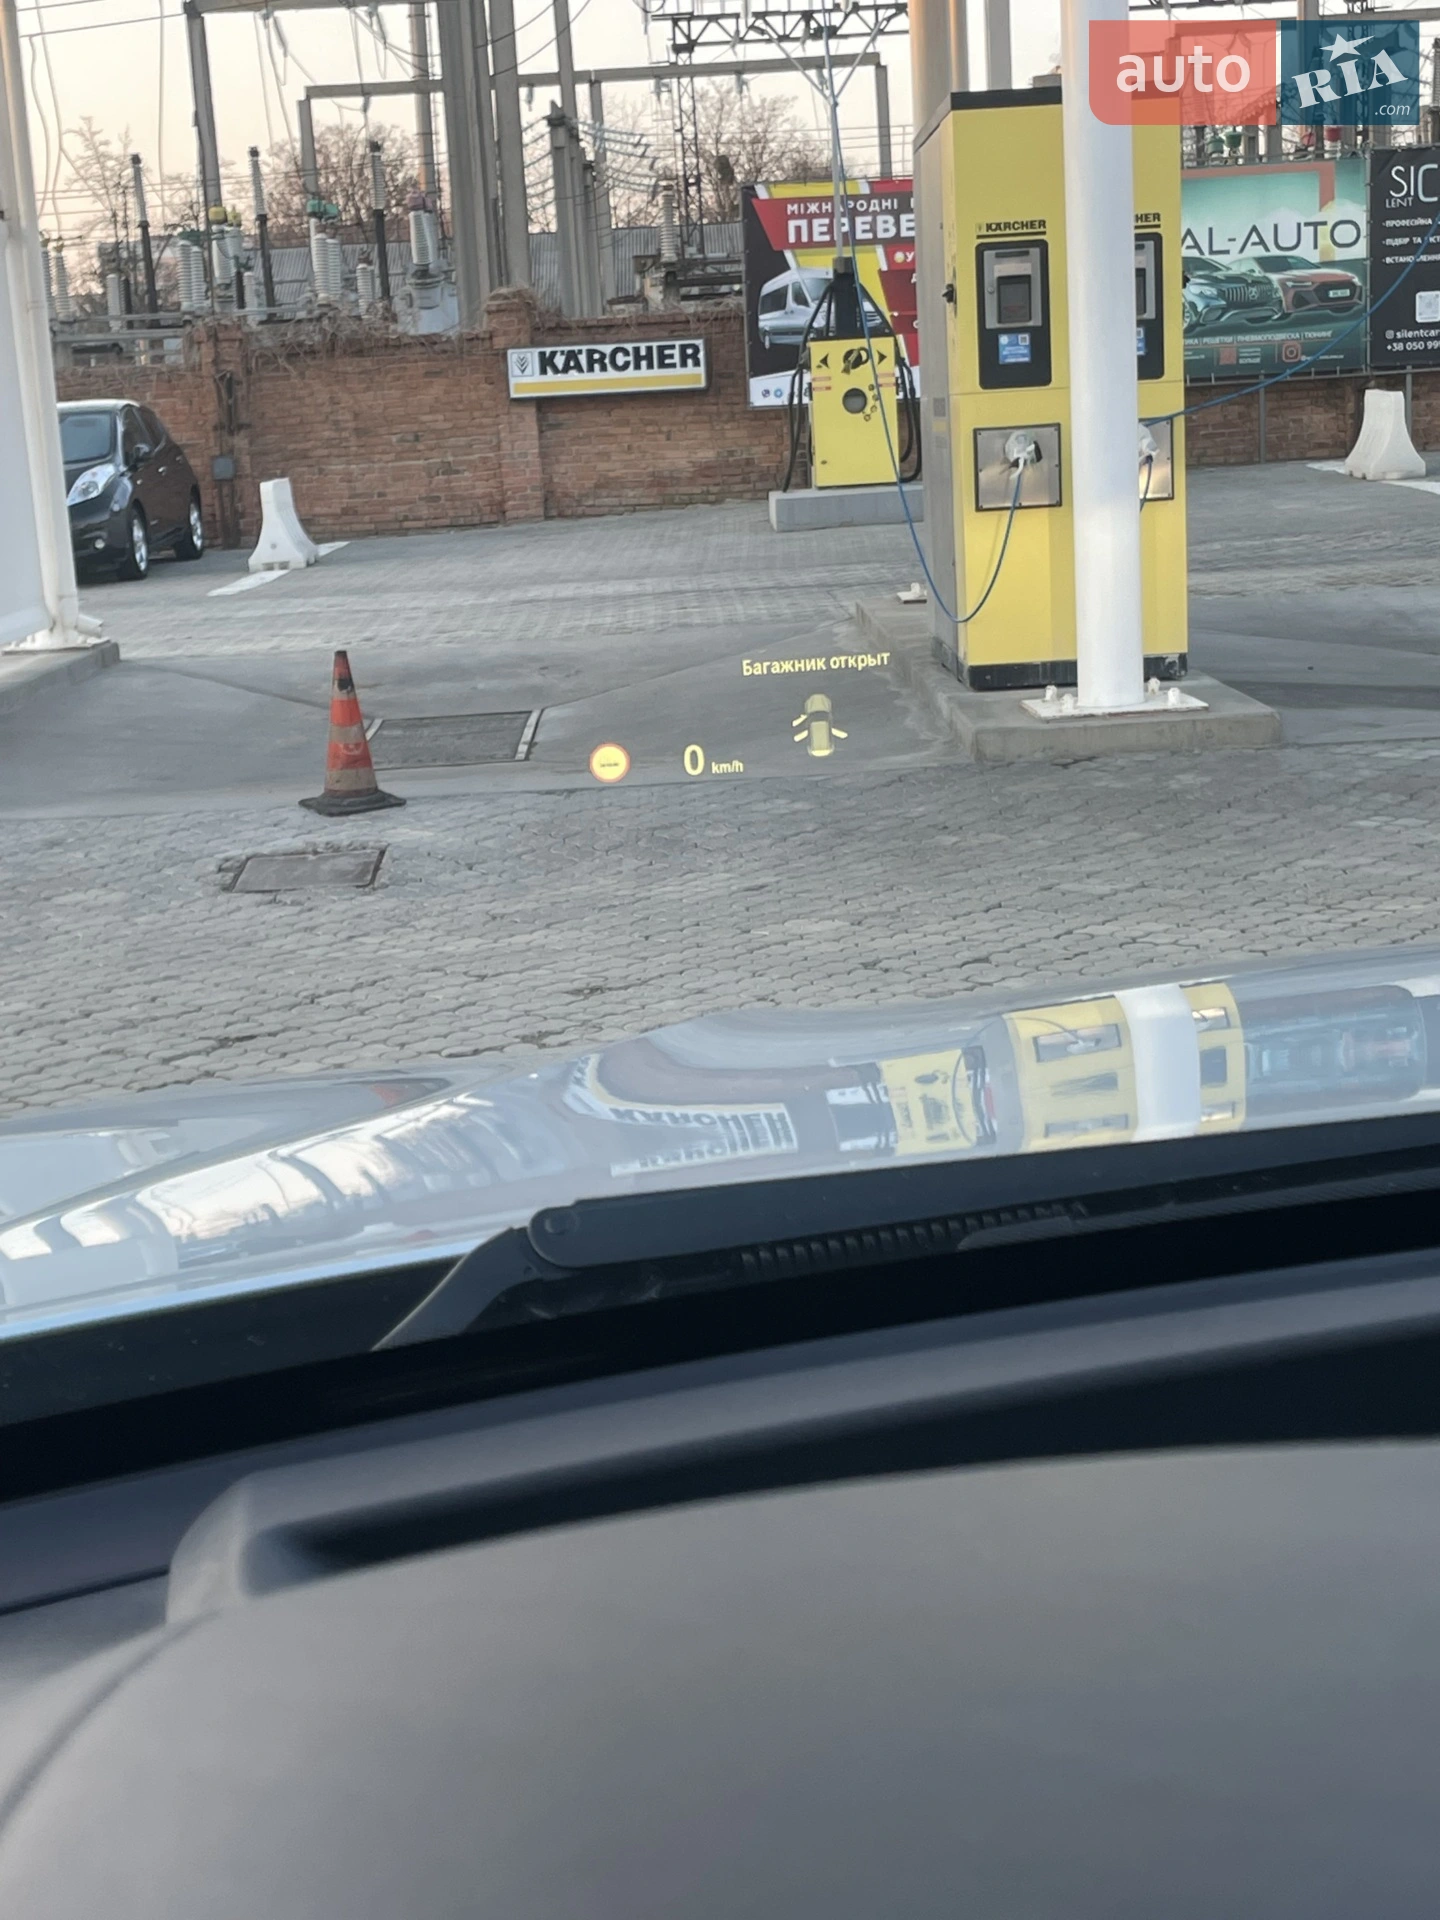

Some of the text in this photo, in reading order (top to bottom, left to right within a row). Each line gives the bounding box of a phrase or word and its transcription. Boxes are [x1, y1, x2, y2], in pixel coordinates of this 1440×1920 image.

[786, 198, 898, 215] МІЖНРОДНІ
[1385, 197, 1413, 208] LENT
[985, 219, 1047, 233] KÄRCHER
[1405, 340, 1425, 351] 050
[538, 343, 701, 376] KÄRCHER
[742, 651, 891, 676] Багажник открыт
[683, 744, 744, 776] 0 km/h
